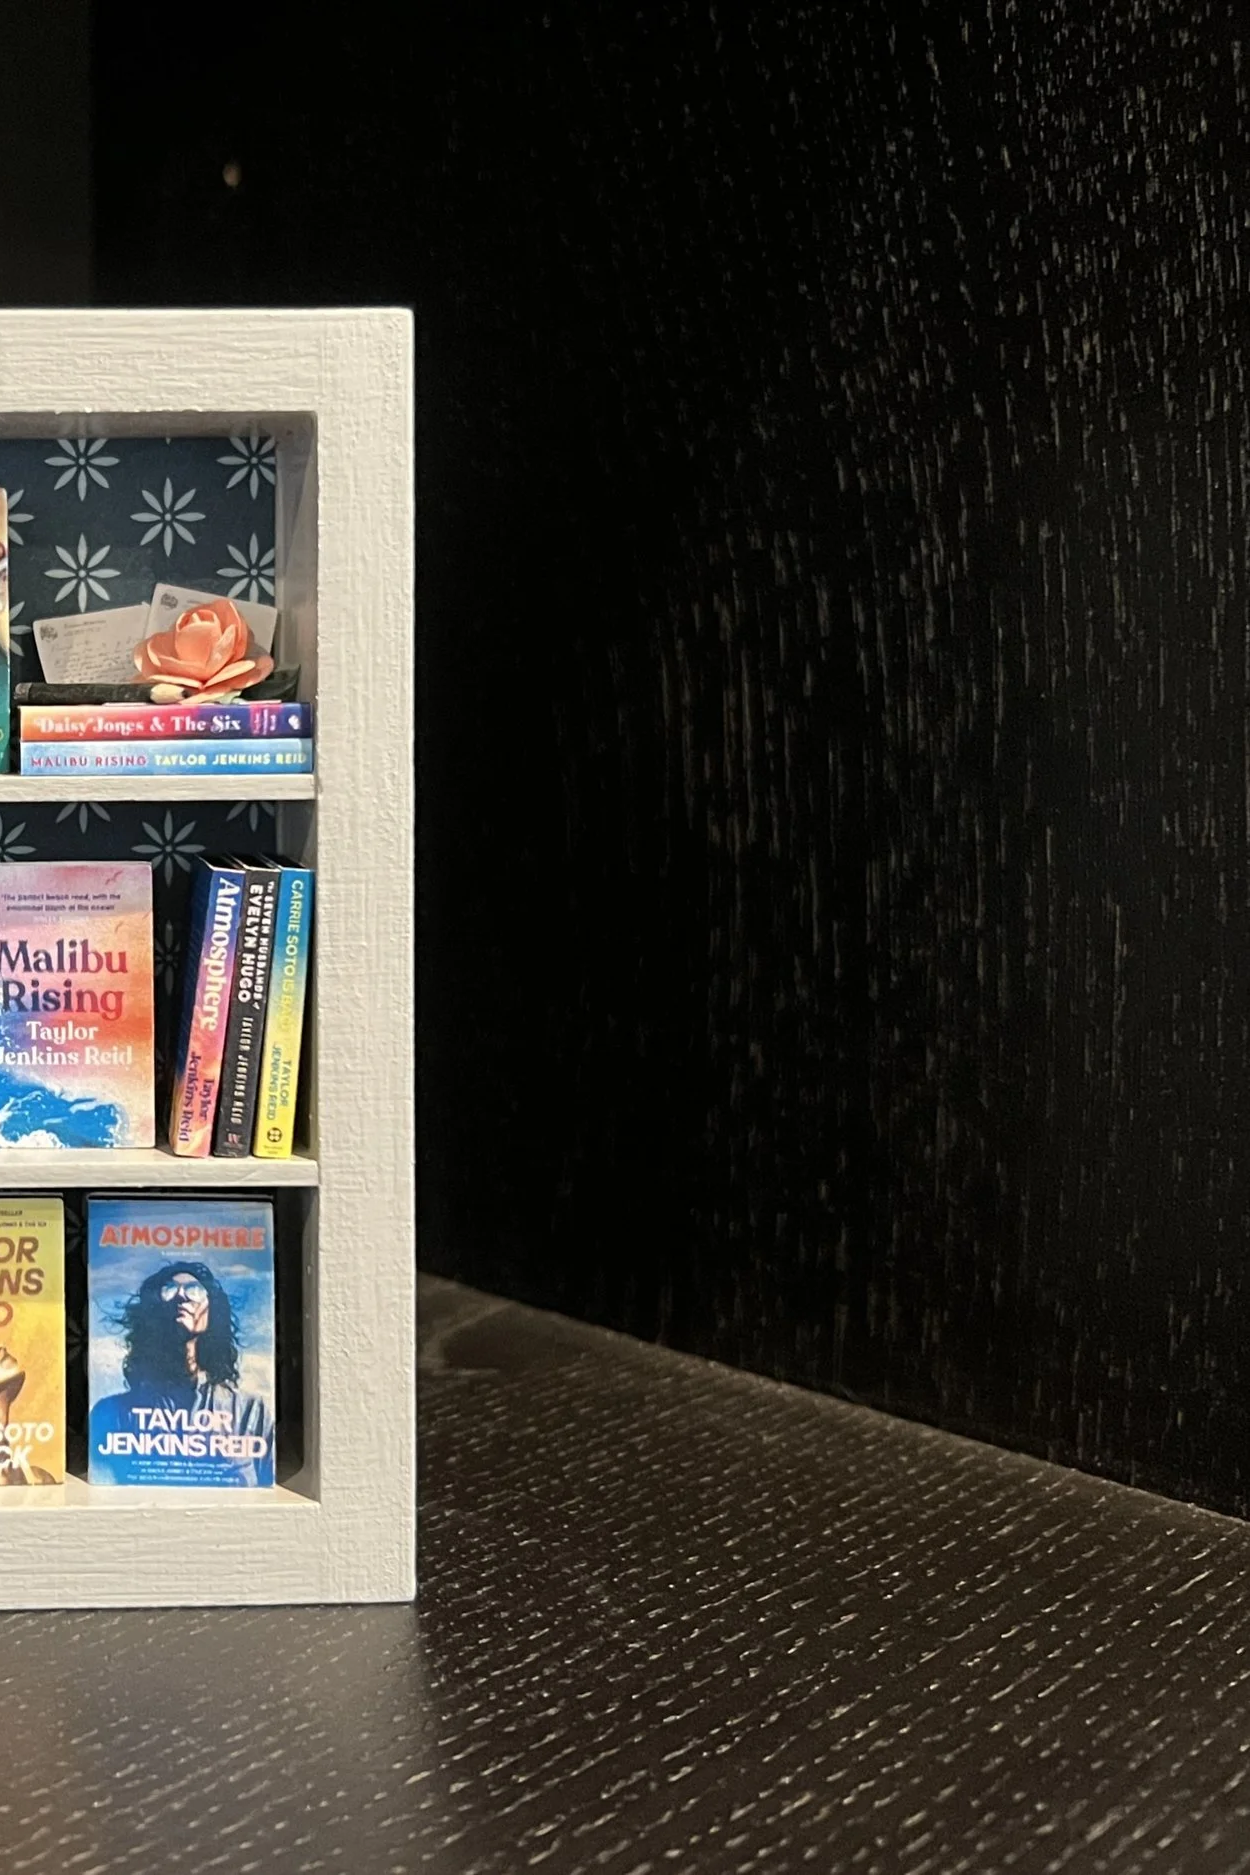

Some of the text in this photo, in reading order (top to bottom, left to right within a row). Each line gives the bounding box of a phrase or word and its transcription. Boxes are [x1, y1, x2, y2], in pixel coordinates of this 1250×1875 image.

[34, 716, 93, 737] Daisy
[93, 716, 144, 736] Jones
[150, 716, 165, 732] &
[170, 715, 206, 732] The
[210, 714, 242, 733] Six
[31, 755, 147, 767] MALIBU RISING
[154, 753, 307, 766] TAYLOR JENKINS REID
[261, 895, 274, 934] SEVEN
[287, 880, 304, 933] CARRIE
[200, 877, 241, 1031] Atmosphere
[238, 884, 263, 1003] EVELYN HUGO
[283, 935, 299, 977] SOTO
[253, 937, 269, 1000] HUSBANDS
[282, 979, 294, 992] IS
[1, 977, 124, 1021] Rising
[26, 1021, 99, 1045] Taylor
[85, 1045, 132, 1066] Reid
[179, 1051, 201, 1141] Jenkins Reid
[199, 1079, 215, 1120] Taylor
[266, 1045, 282, 1121] JENKINS REID
[280, 1060, 291, 1107] TAYLOR
[100, 1224, 265, 1249] ATMOSPHERE
[132, 1408, 233, 1432] TAYLOR
[98, 1432, 268, 1458] JENKINS REID
